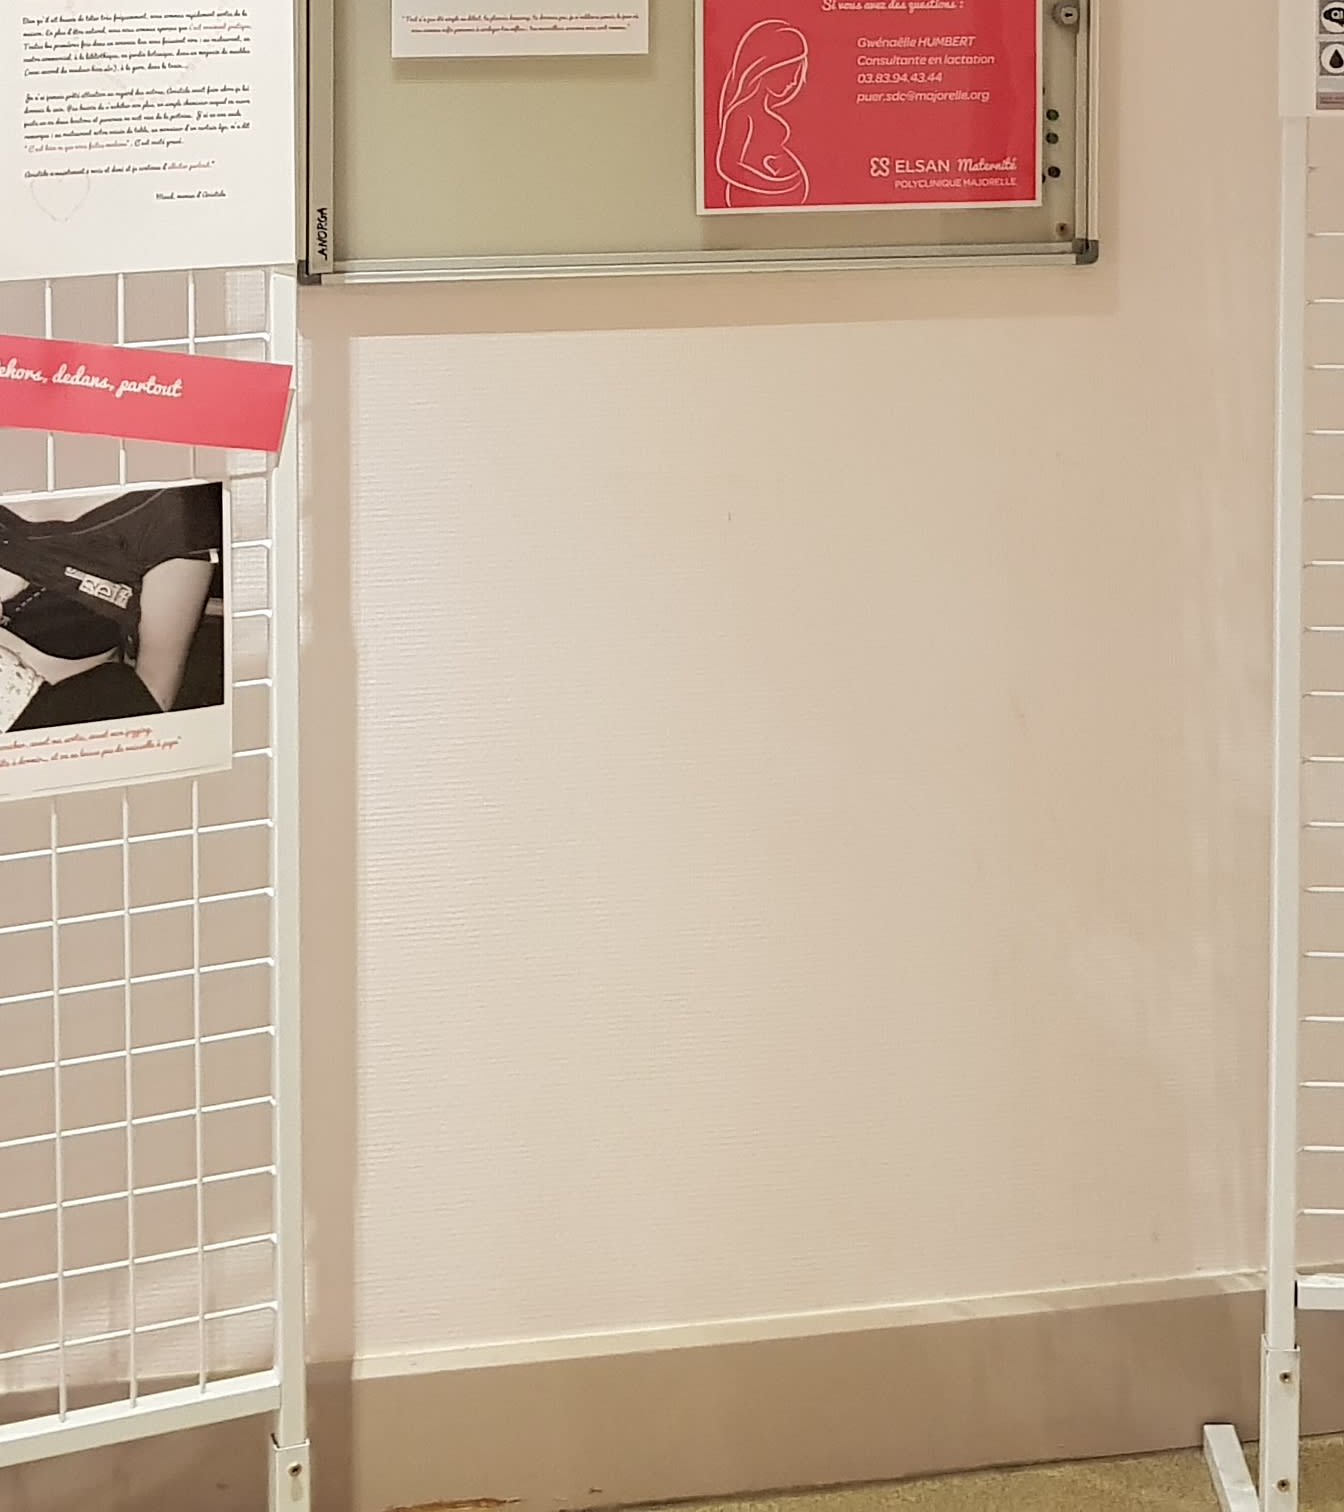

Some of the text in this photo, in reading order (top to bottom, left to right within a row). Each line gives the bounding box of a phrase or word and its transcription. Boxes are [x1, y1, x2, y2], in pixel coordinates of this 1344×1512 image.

[918, 37, 976, 47] HUMBERT
[858, 56, 926, 65] Consultante
[944, 54, 994, 64] lactation
[858, 73, 942, 83] 03.83.94.43.44
[896, 157, 1016, 173] ELSAN Maternité
[963, 178, 1017, 187] MAJORELLE
[52, 364, 114, 391] dedans,
[116, 376, 182, 398] partout
